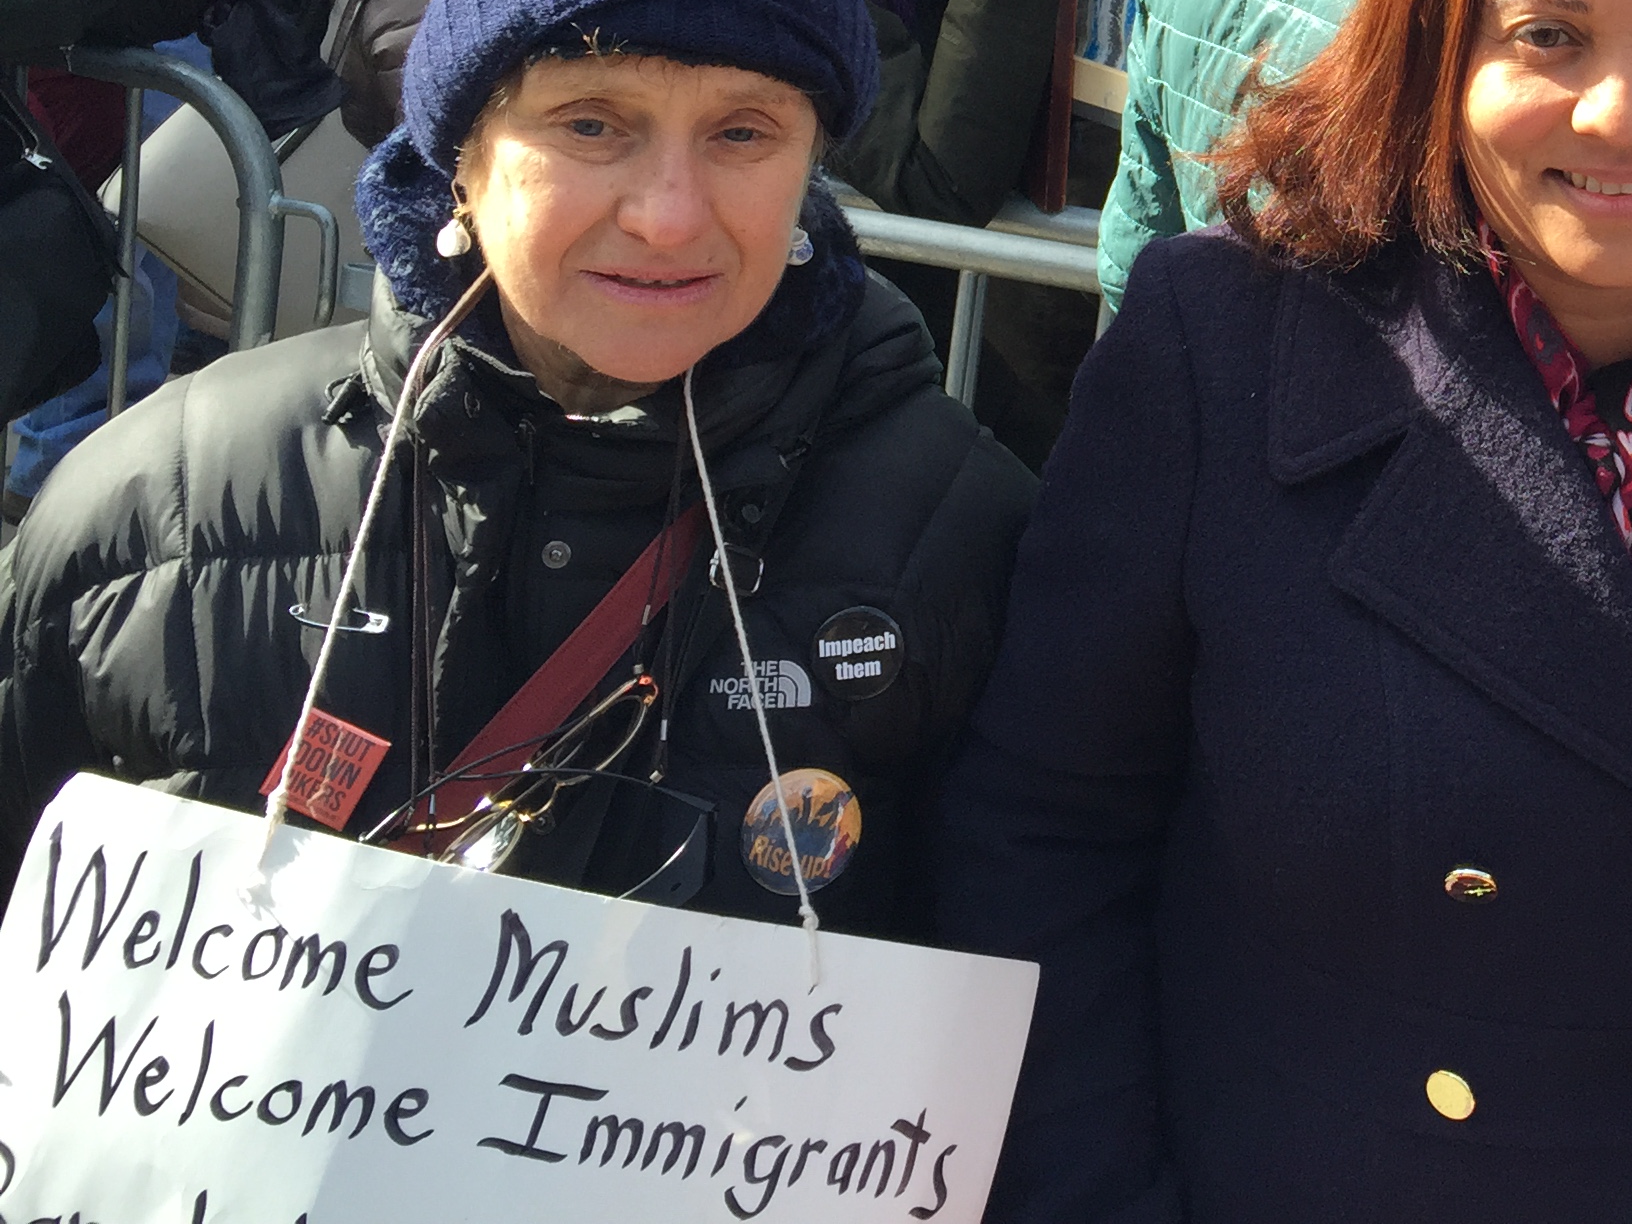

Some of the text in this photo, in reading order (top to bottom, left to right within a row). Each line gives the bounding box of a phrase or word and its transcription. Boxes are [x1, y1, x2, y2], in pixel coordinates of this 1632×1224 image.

[818, 631, 896, 658] Impeach
[709, 676, 778, 694] NORTH
[740, 660, 778, 677] THE
[835, 660, 882, 681] them
[727, 693, 777, 710] FACE
[306, 716, 376, 762] #SHUT
[294, 739, 362, 790] DOWN
[287, 768, 347, 812] IKERS
[36, 820, 414, 1011] Welcome
[52, 989, 435, 1147] Welcome
[476, 1072, 957, 1221] Immigrants
